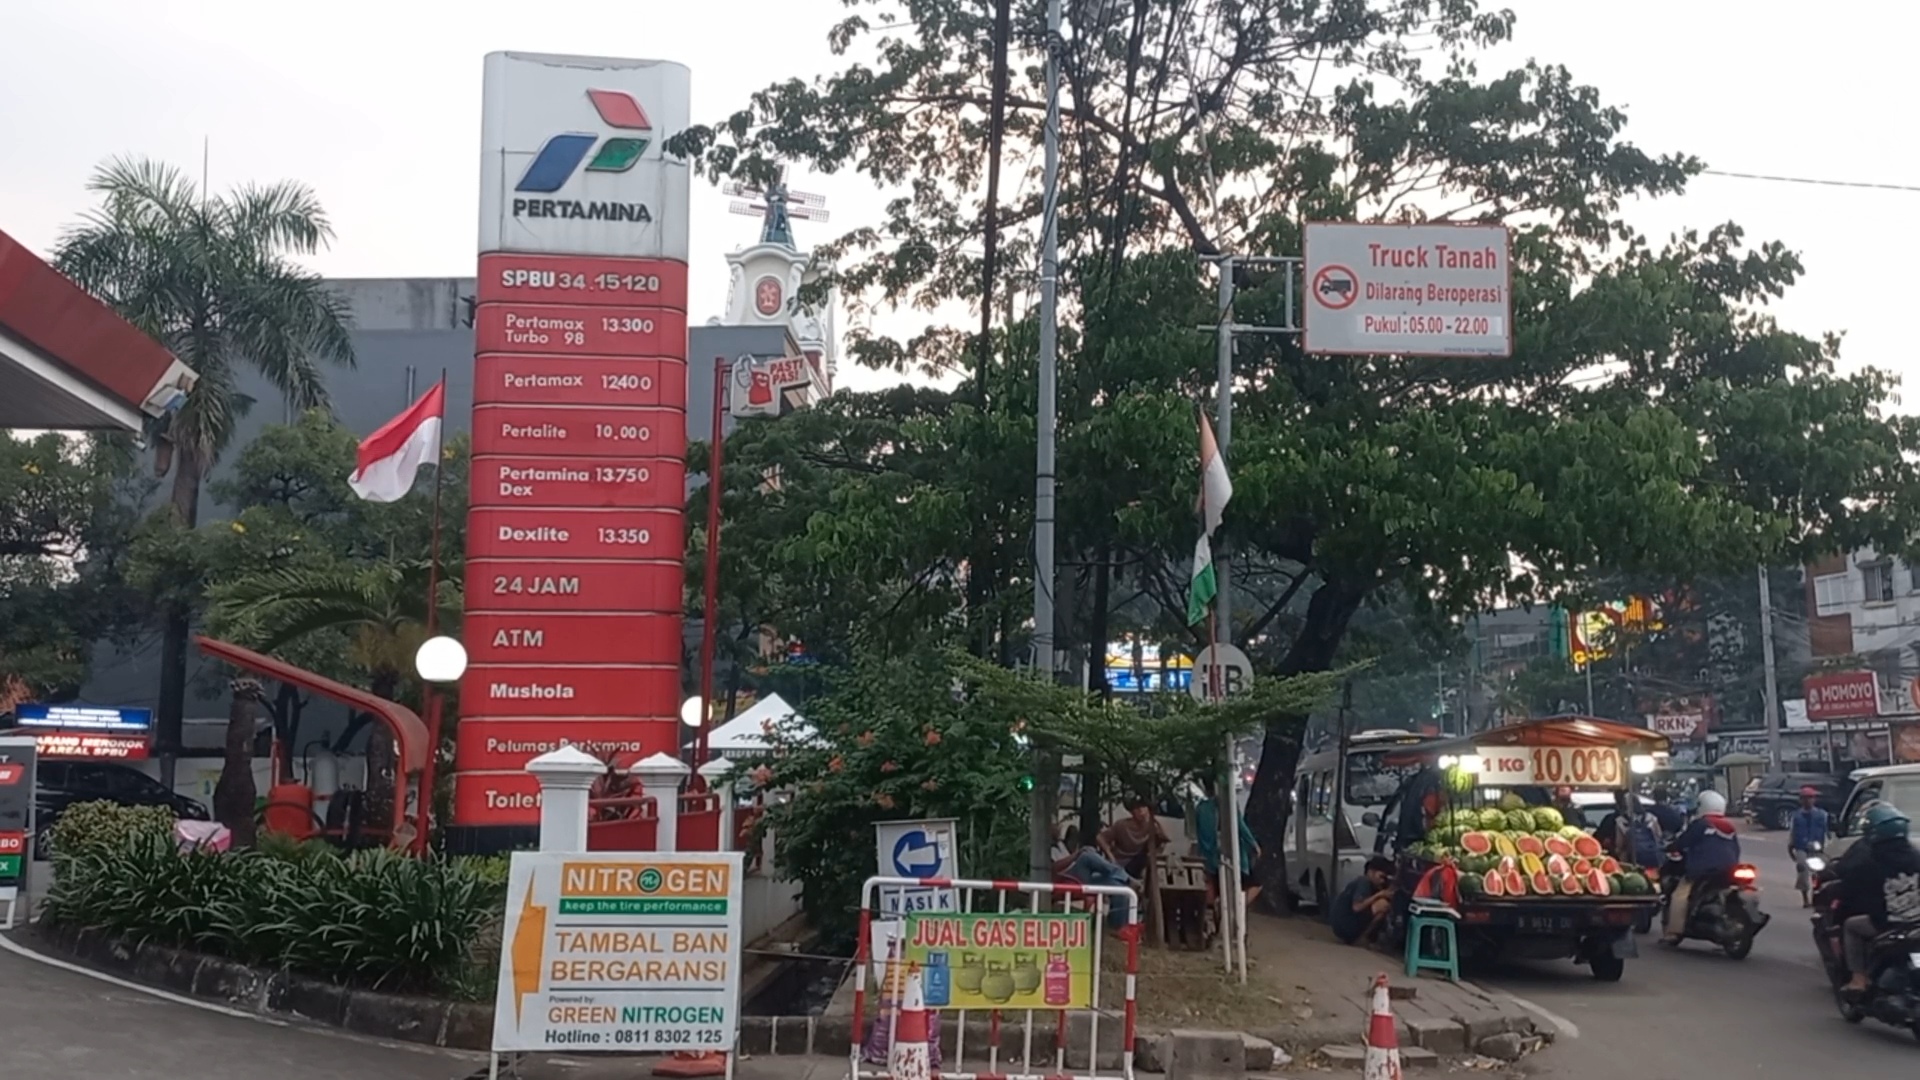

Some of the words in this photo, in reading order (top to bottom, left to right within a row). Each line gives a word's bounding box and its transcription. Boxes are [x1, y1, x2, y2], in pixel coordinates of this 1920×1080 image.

[512, 198, 652, 222] PERTAMINA
[1368, 243, 1429, 268] Truck
[1434, 244, 1497, 269] Tanah
[502, 270, 555, 287] SPBU
[1366, 282, 1422, 306] Dilarang
[1427, 283, 1502, 306] Beroperasi
[506, 314, 585, 331] Pertamax
[1365, 316, 1401, 334] Pukul
[1409, 317, 1443, 334] 05.00
[1455, 317, 1489, 335] 22.00
[505, 329, 549, 344] Turbo
[564, 332, 585, 345] 98
[504, 373, 583, 388] Pertamax
[502, 424, 567, 438] Pertalite
[596, 424, 650, 441] 10.000
[499, 466, 590, 481] Pertamina
[499, 482, 534, 496] Dex
[498, 526, 569, 541] Dexlite
[493, 577, 524, 594] 24
[527, 577, 580, 594] JAM
[493, 630, 543, 647] ATM
[490, 684, 574, 698] Mushola
[1821, 682, 1873, 702] MOMOYO
[47, 746, 89, 755] AREAL
[93, 747, 129, 757] SPBU
[82, 737, 145, 749] MEROKOK
[487, 738, 556, 752] Pelumas
[1483, 758, 1491, 772] 1
[1498, 758, 1525, 772] KG
[1533, 748, 1617, 783] 10.000
[565, 901, 594, 912] keep
[597, 901, 617, 910] the
[619, 901, 641, 911] tire
[643, 901, 722, 912] performance
[555, 932, 664, 953] TAMBAL
[672, 932, 728, 953] BAN
[912, 920, 967, 947] JUAL
[973, 920, 1017, 947] GAS
[1023, 921, 1086, 948] ELPIJI
[551, 961, 727, 981] BERGARANSI
[549, 995, 583, 1003] Powered
[548, 1007, 617, 1024] GREEN
[621, 1007, 724, 1024] NITROGEN
[545, 1030, 601, 1043] Hotline
[615, 1030, 649, 1043] 0811
[654, 1030, 691, 1043] 8302
[697, 1030, 723, 1043] 125
